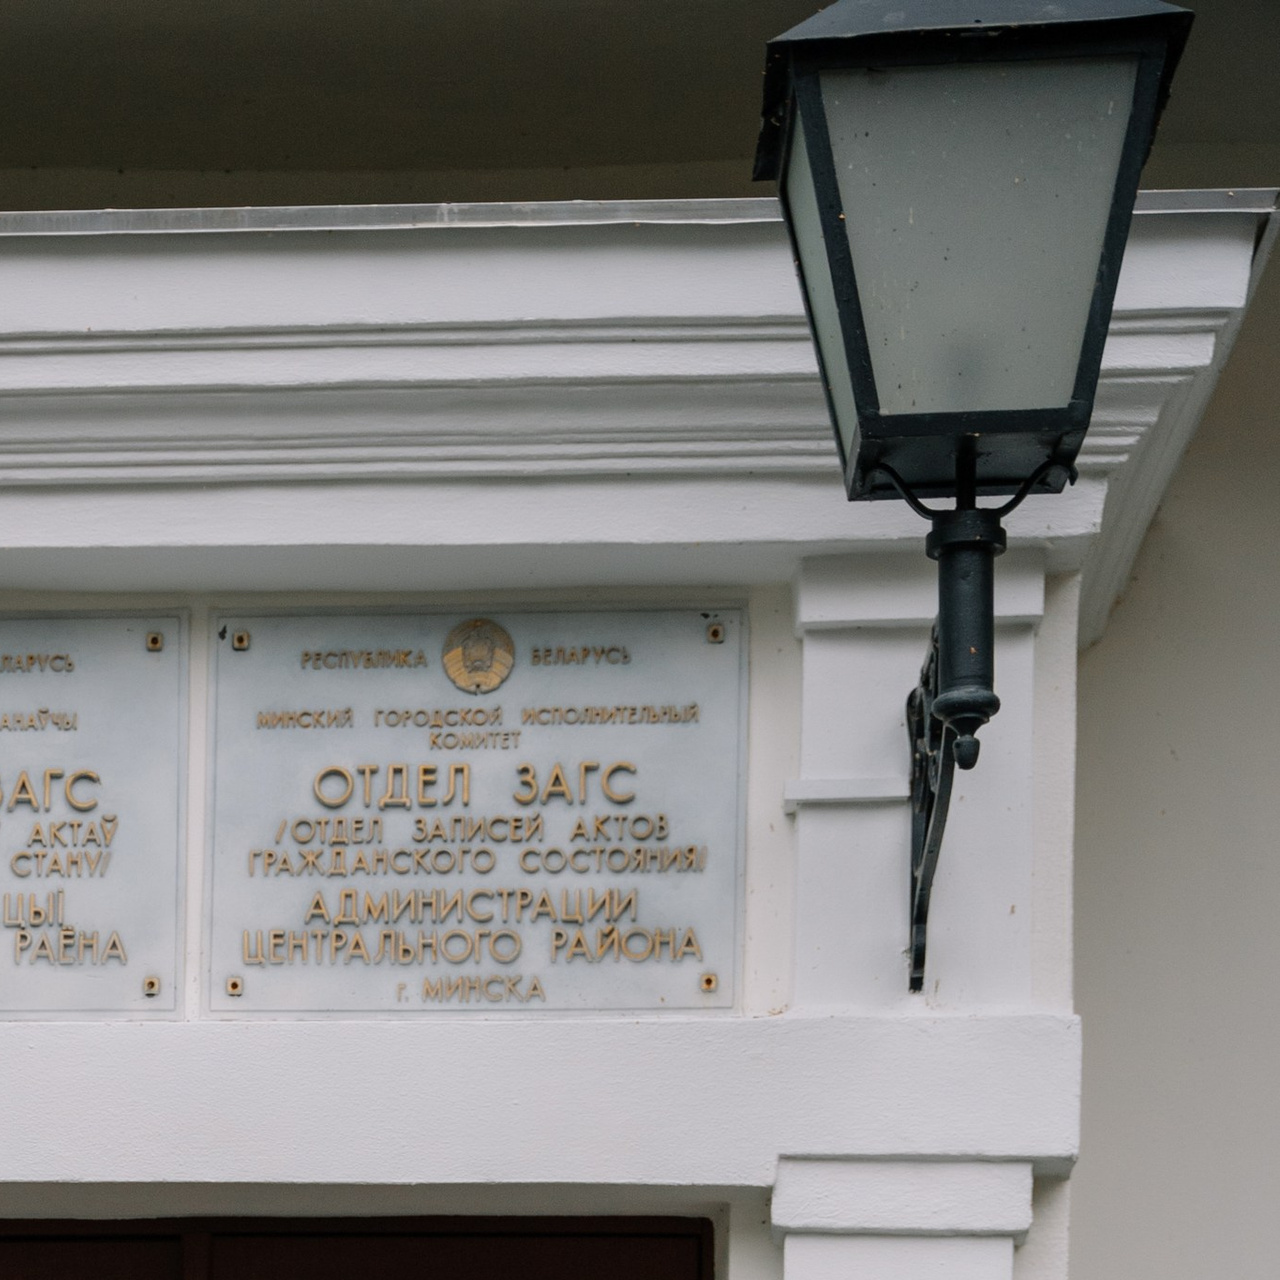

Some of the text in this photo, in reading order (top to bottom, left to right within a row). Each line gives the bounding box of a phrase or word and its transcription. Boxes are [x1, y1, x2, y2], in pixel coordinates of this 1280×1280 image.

[301, 645, 631, 670] РЕСПУБЛИКА БЕЛАРУСЬ
[257, 702, 700, 729] МИНСКИЙ ГОРОДСКОЙ ИСПОЛНИТЕЛЬНЫЙ
[429, 730, 522, 751] КОМИТЕТ
[313, 761, 637, 810] ОТДЕЛ ЗАГС
[27, 814, 118, 848] АКТАЎ
[275, 813, 669, 845] /ОТДЕЛ ЗАПИСЕЙ АКТОВ
[248, 848, 496, 877] ГРАЖДАНСКОГО
[304, 888, 638, 927] АДМИНИСТРАЦИИ
[14, 927, 128, 967] РАЁНА
[241, 925, 703, 967] ЦЕНТРАЛЬНОГО РАЙОНА
[422, 975, 546, 1003] МИНСКА
